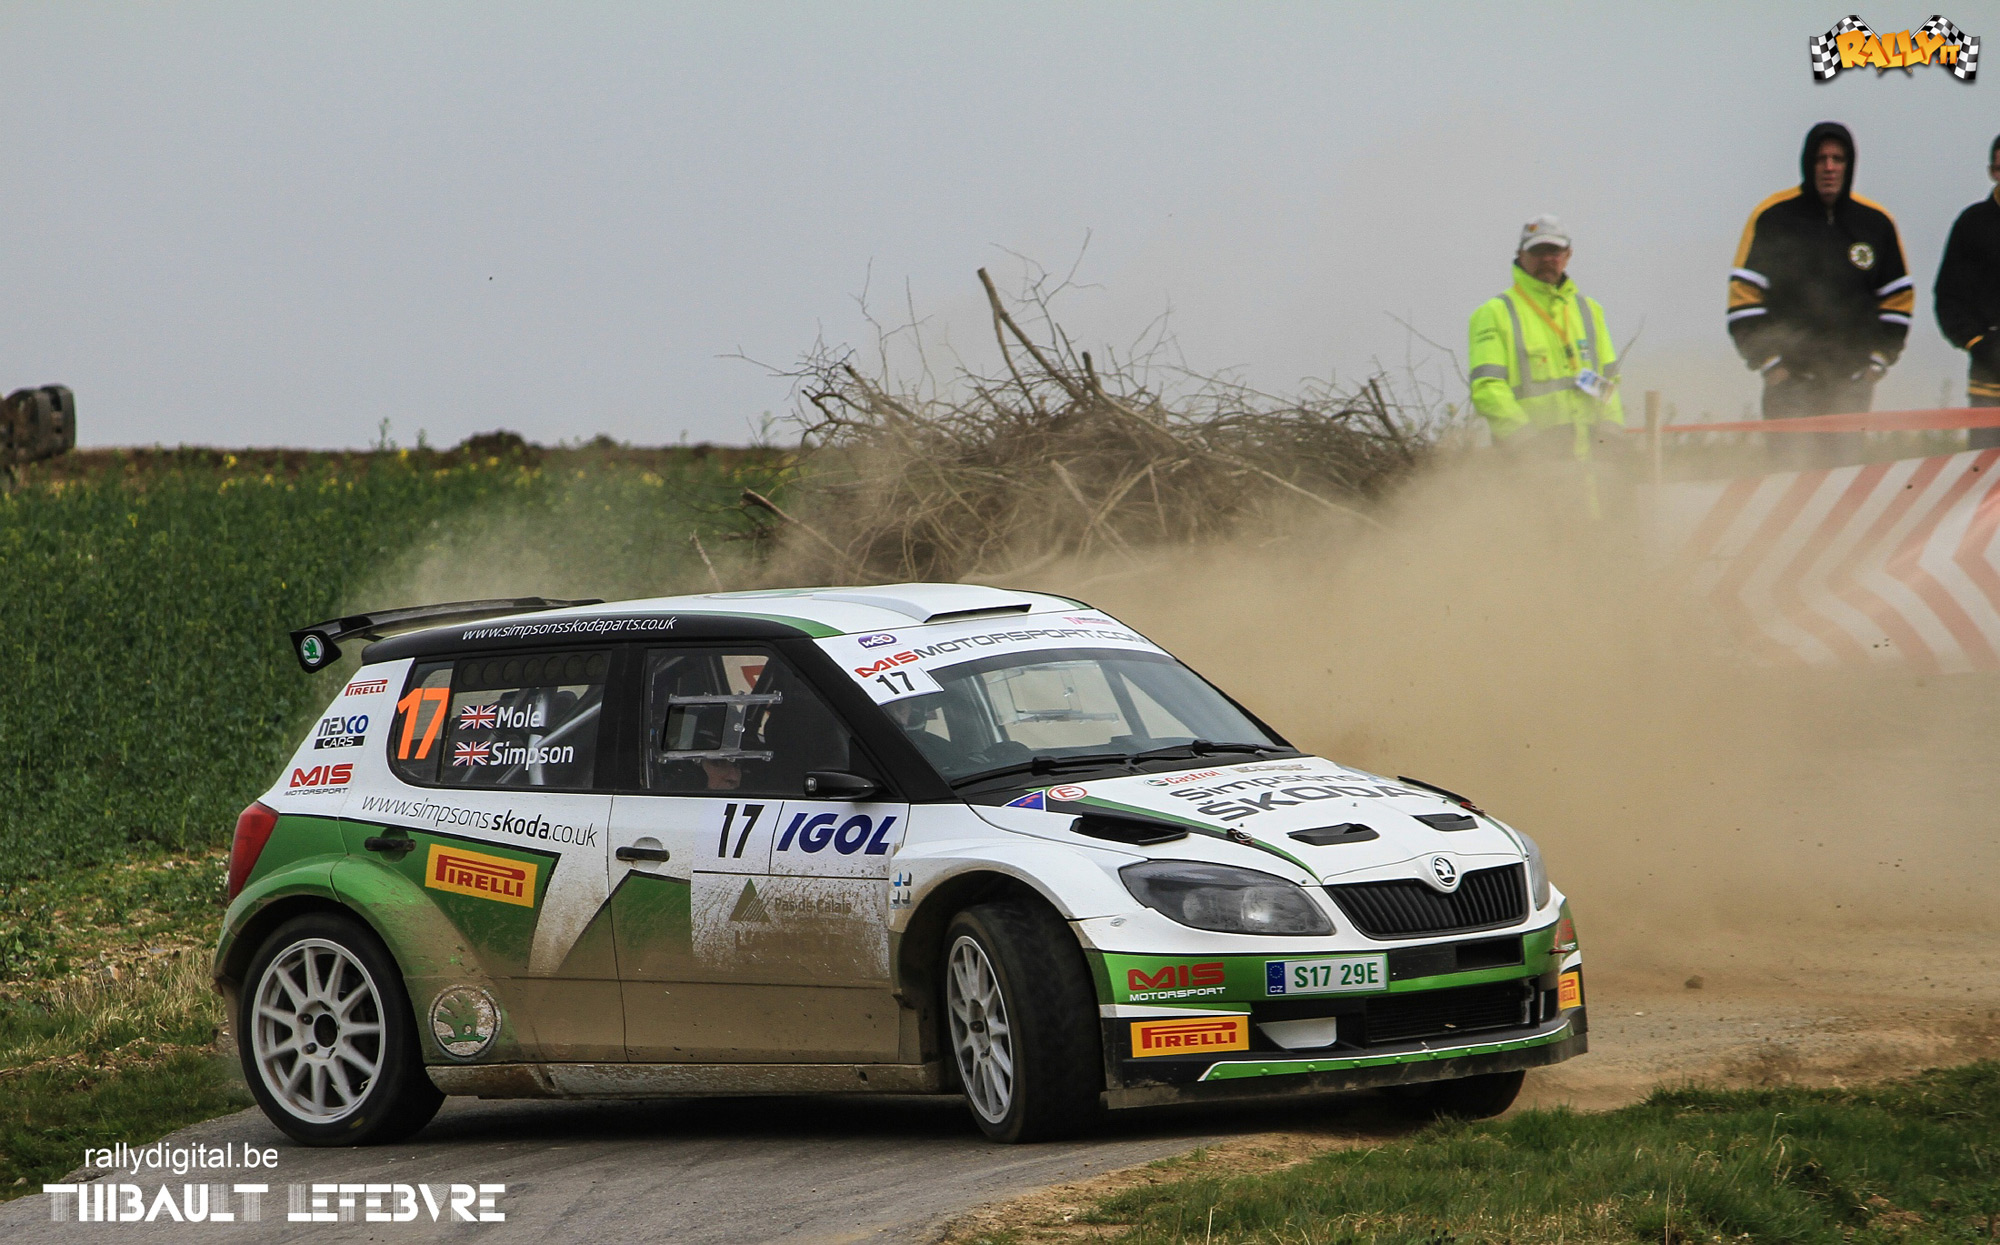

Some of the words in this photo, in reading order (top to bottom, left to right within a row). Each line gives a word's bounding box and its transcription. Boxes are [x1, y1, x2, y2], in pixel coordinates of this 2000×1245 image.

[462, 616, 677, 640] www.simpsonsskodaparts.co.uk
[344, 679, 388, 697] PIRELLI
[876, 671, 915, 695] 17
[317, 714, 369, 737] NESCO
[397, 687, 451, 760] 17
[496, 704, 543, 729] Mole
[322, 737, 355, 747] CARS
[490, 742, 574, 771] Simpson
[289, 763, 354, 788] MIS
[1164, 770, 1223, 785] Castrol
[1169, 775, 1368, 801] Simpsons
[284, 787, 348, 796] MOTORSPORT
[362, 795, 598, 847] www.simpsonsskoda.co.uk
[718, 803, 765, 858] 17
[776, 812, 898, 855] IGOL
[435, 854, 527, 898] PIRELLI
[1127, 962, 1226, 991] MIS
[1294, 965, 1332, 988] S17
[1340, 962, 1379, 985] 29E
[1129, 987, 1226, 1002] MOTORSPORT
[1141, 1021, 1238, 1049] PIRELLI
